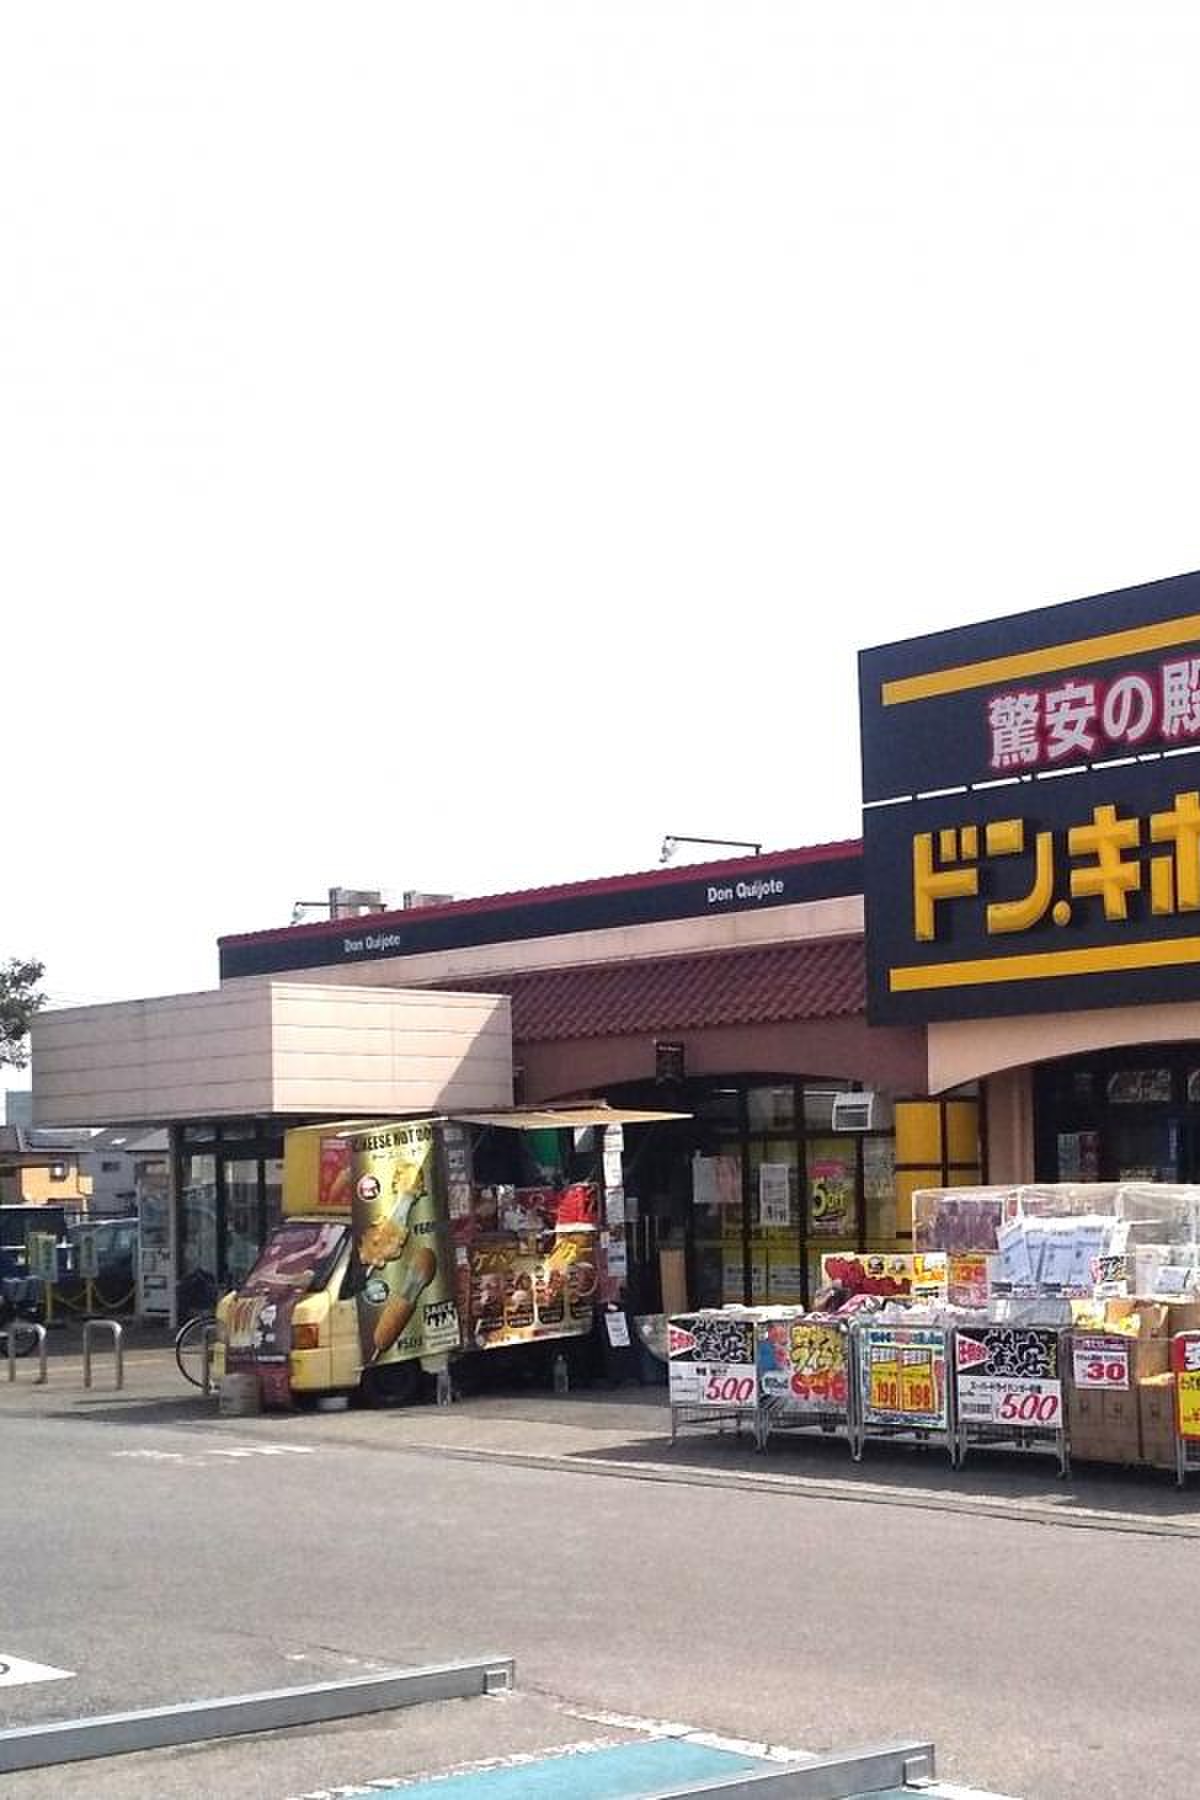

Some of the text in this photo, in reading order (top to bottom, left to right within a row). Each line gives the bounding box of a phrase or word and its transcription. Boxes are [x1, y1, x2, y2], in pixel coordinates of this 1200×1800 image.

[707, 879, 784, 903] Don Quijote
[343, 932, 401, 953] Don Quijote
[1086, 1362, 1126, 1381] 30
[705, 1377, 755, 1401] 500
[877, 1382, 897, 1404] 198
[909, 1383, 931, 1406] 198
[1001, 1393, 1058, 1421] 500
